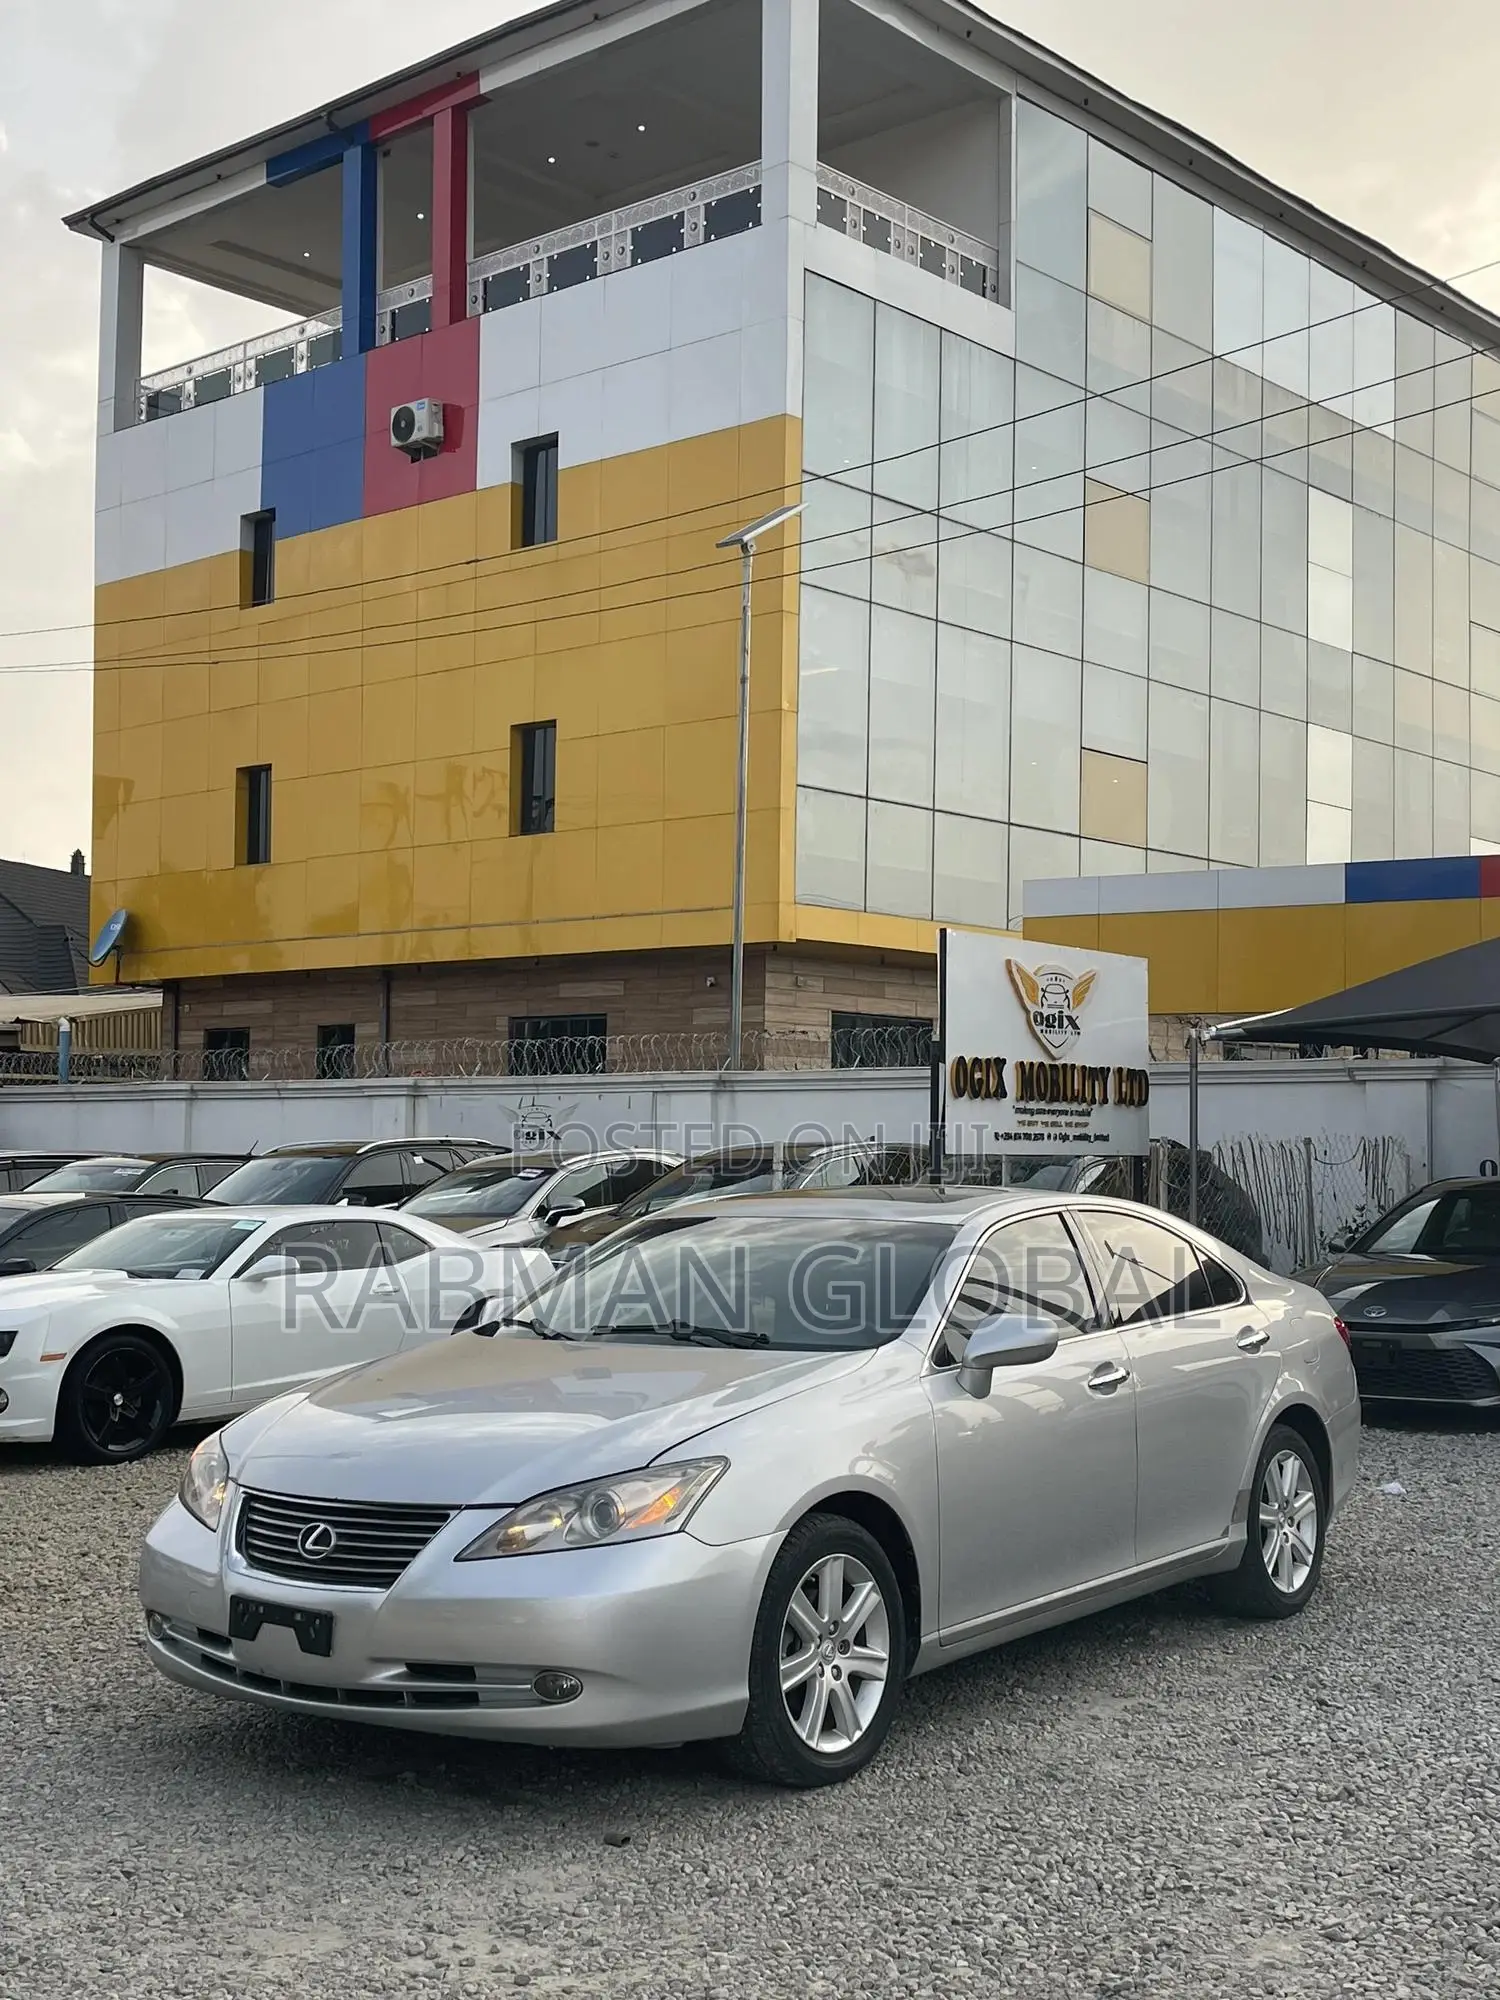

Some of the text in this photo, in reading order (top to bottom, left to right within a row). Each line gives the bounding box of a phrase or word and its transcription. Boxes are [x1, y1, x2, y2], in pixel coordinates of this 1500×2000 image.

[951, 1055, 1150, 1107] OGIX MOBILITY LTD
